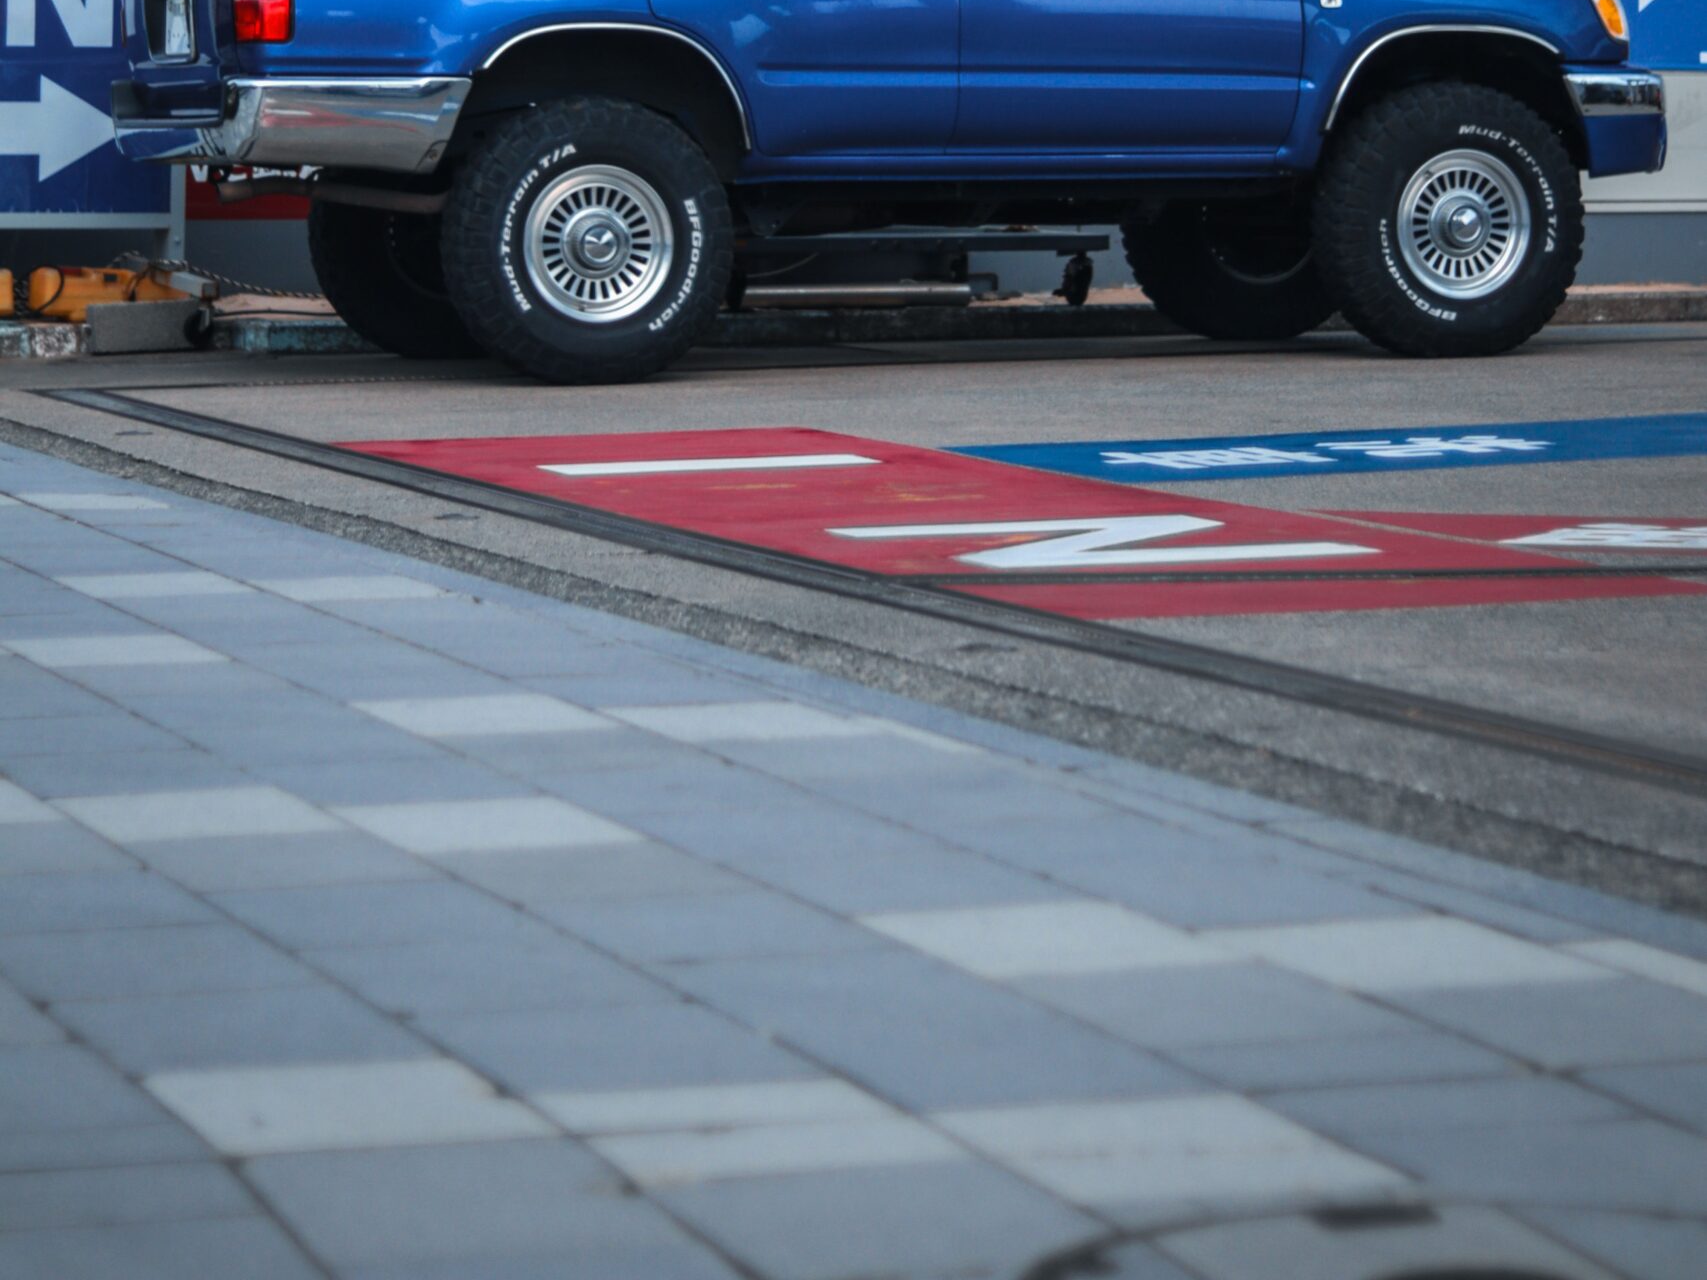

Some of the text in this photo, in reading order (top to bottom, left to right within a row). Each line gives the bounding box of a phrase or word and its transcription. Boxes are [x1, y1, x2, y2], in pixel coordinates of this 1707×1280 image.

[500, 142, 578, 313] Mud-Terrain T/A
[1457, 123, 1559, 254] Mud-Terrain T/A
[648, 196, 704, 332] BFGoodrich
[1378, 218, 1458, 322] BFGoodrich
